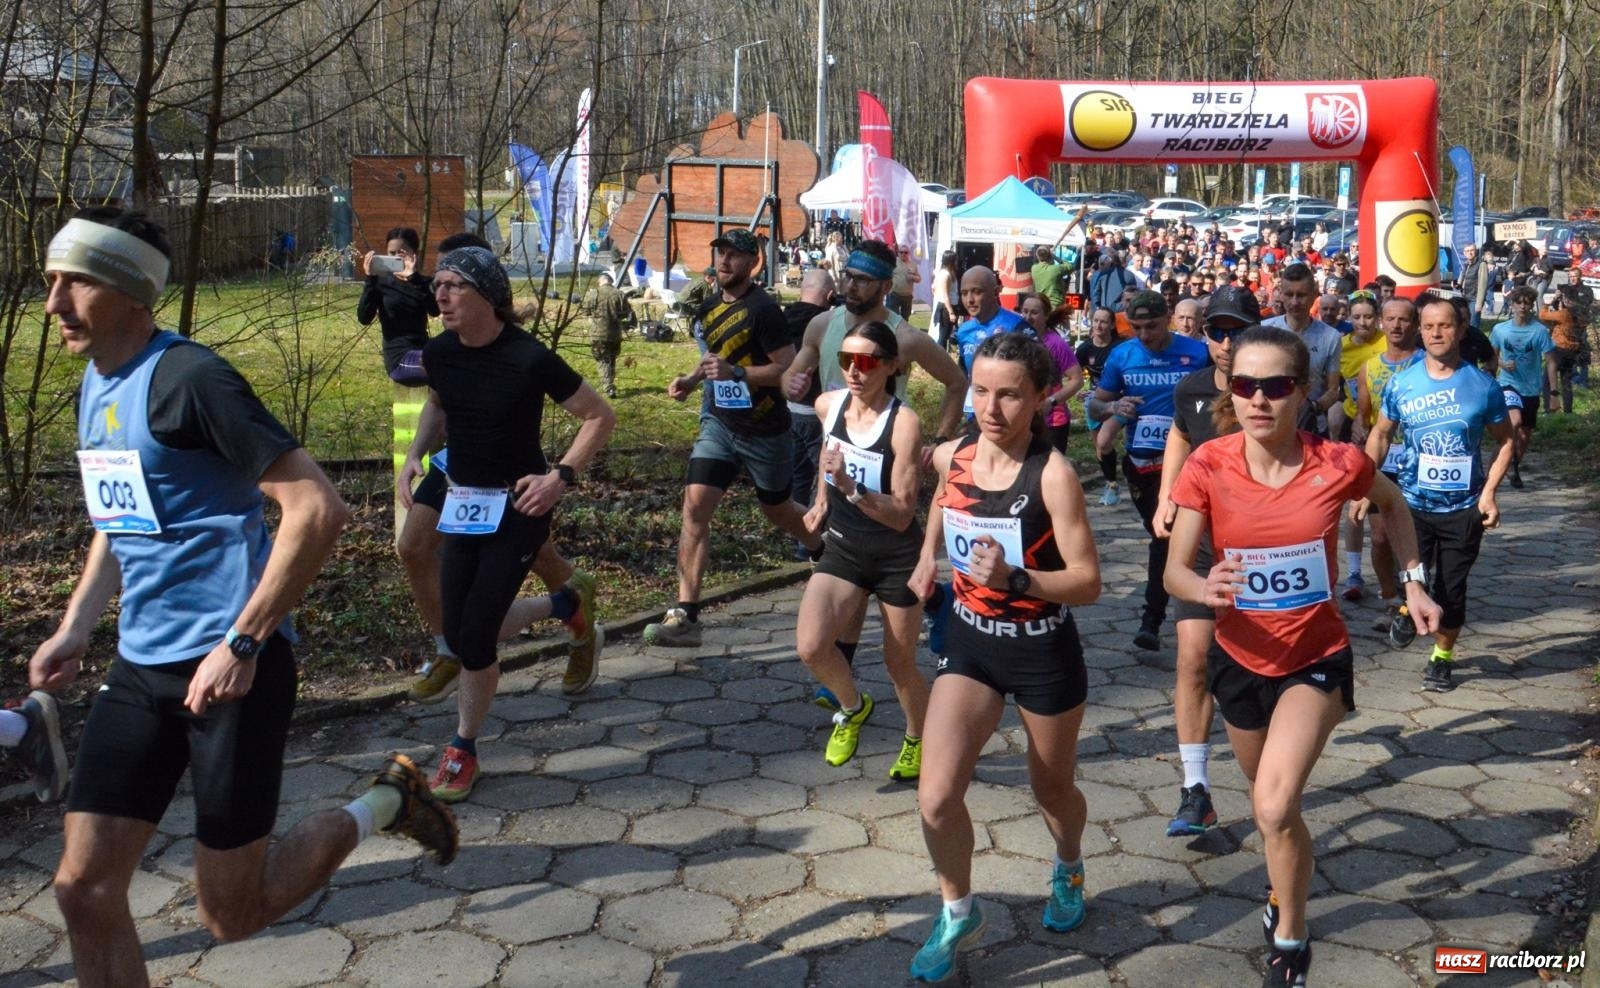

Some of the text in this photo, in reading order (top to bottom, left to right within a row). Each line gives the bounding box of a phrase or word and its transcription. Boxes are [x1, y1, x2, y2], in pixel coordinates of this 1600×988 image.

[1191, 92, 1244, 105] BIEG
[1150, 113, 1289, 129] TWARDZIELA
[1161, 134, 1274, 152] RACIBÓRZ
[718, 385, 743, 399] 080
[1401, 387, 1457, 417] MORSY
[1427, 467, 1462, 482] 030
[98, 479, 137, 511] 003
[455, 503, 491, 523] 021
[1247, 567, 1311, 595] 063
